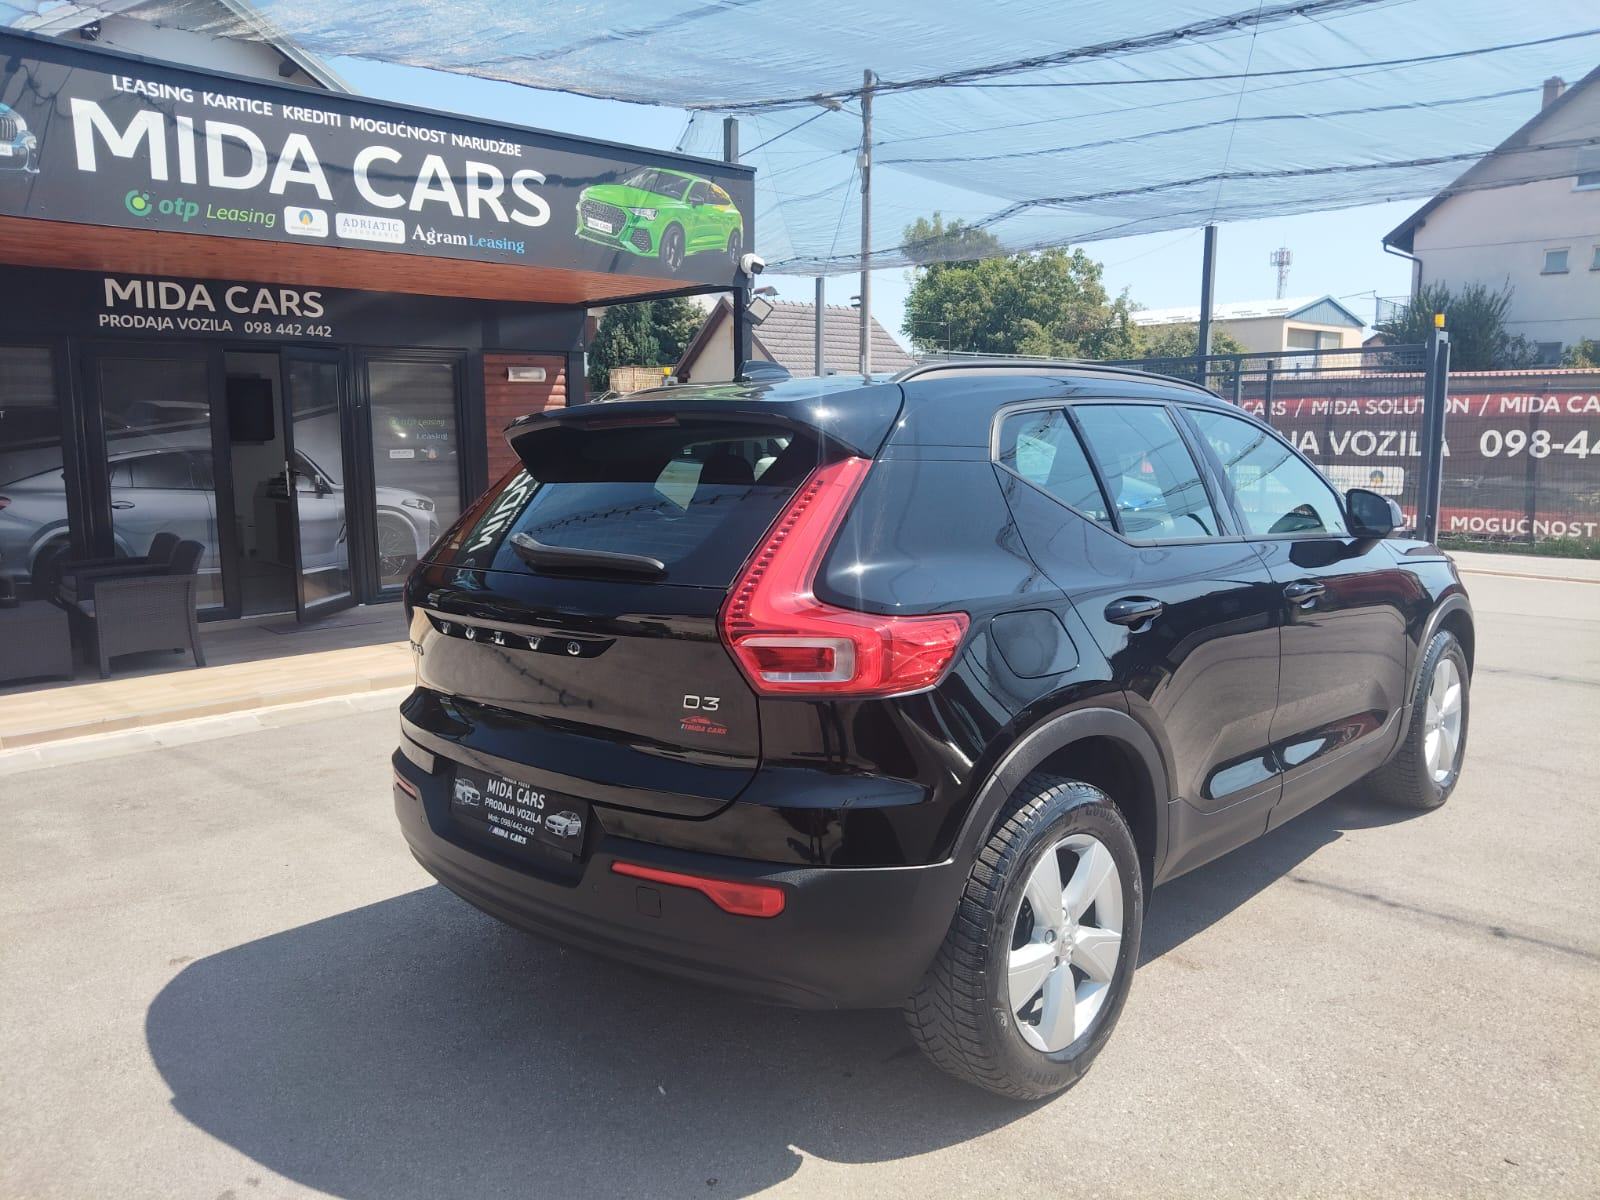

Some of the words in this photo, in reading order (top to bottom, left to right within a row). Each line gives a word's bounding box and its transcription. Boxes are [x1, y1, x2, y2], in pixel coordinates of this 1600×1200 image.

[112, 75, 194, 103] LEASING
[203, 92, 273, 116] KARTICE
[282, 105, 341, 127] KREDITI
[350, 116, 447, 144] MOGUĆNOST
[451, 133, 522, 157] NARUDŽBE
[70, 97, 334, 201] MIDA
[353, 145, 551, 227] CARS
[159, 198, 199, 222] otp
[206, 203, 276, 228] Leasing
[343, 217, 400, 232] ADRIATIC
[104, 278, 216, 312] MIDA
[224, 285, 325, 318] CARS
[99, 314, 174, 331] PRODAJA
[177, 318, 233, 332] VOZILA
[244, 321, 272, 335] 098
[275, 323, 303, 336] 442
[306, 325, 333, 338] 442
[1311, 399, 1360, 416] MIDA
[1500, 396, 1560, 413] MIDA
[439, 621, 581, 656] VOLVO
[683, 695, 720, 711] D3
[487, 779, 513, 800] MIDA
[516, 788, 545, 810] CARS
[484, 797, 515, 816] PRODAJA
[517, 807, 542, 824] VOZILA
